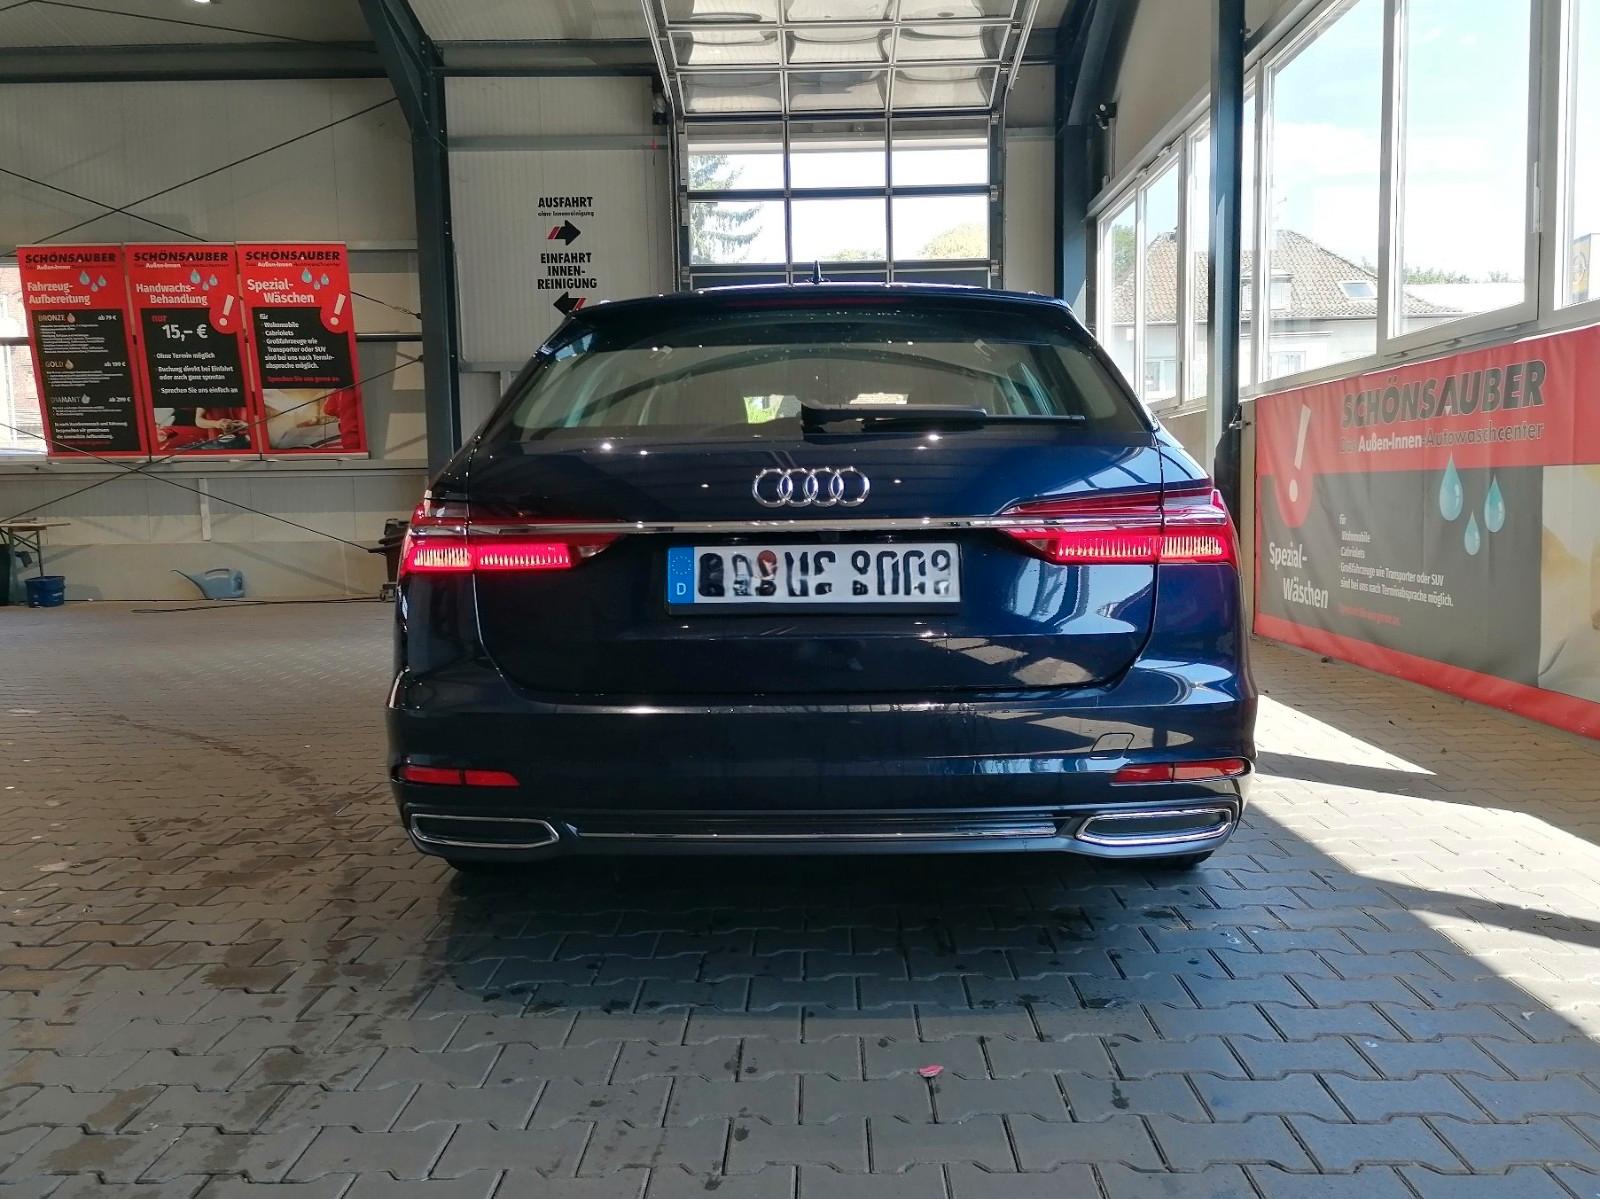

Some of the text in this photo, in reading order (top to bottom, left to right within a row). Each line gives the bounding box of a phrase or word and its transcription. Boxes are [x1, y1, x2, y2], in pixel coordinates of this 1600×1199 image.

[538, 197, 593, 208] AUSFAHRT
[25, 251, 117, 264] SCHÖNSAUBER
[134, 249, 229, 262] SCHÖNSAUBER
[245, 248, 340, 260] SCHÖNSAUBER
[540, 252, 592, 264] EINFAHRT
[547, 265, 586, 277] INNEN-
[27, 281, 74, 294] Fahrzeug-
[136, 282, 196, 293] Handwachs-
[247, 278, 294, 293] Spezial-
[537, 278, 598, 290] REINIGUNG
[29, 294, 91, 306] Aufbereitung
[150, 294, 208, 306] Behandlung
[263, 291, 315, 303] Wäschen
[38, 314, 67, 322] BRONZE
[266, 338, 307, 346] Großfahrzeuge
[192, 352, 216, 360] möglich
[45, 360, 64, 368] GOLD
[265, 362, 295, 370] absprache
[1341, 360, 1547, 429] SCHÖNSAUBER
[1269, 541, 1308, 571] Spezial-
[1385, 567, 1417, 584] Transporter
[1416, 571, 1431, 585] oder
[1431, 573, 1445, 587] SUV
[676, 583, 687, 596] D
[1283, 576, 1329, 609] Wäschen
[1427, 591, 1454, 608] möglich.
